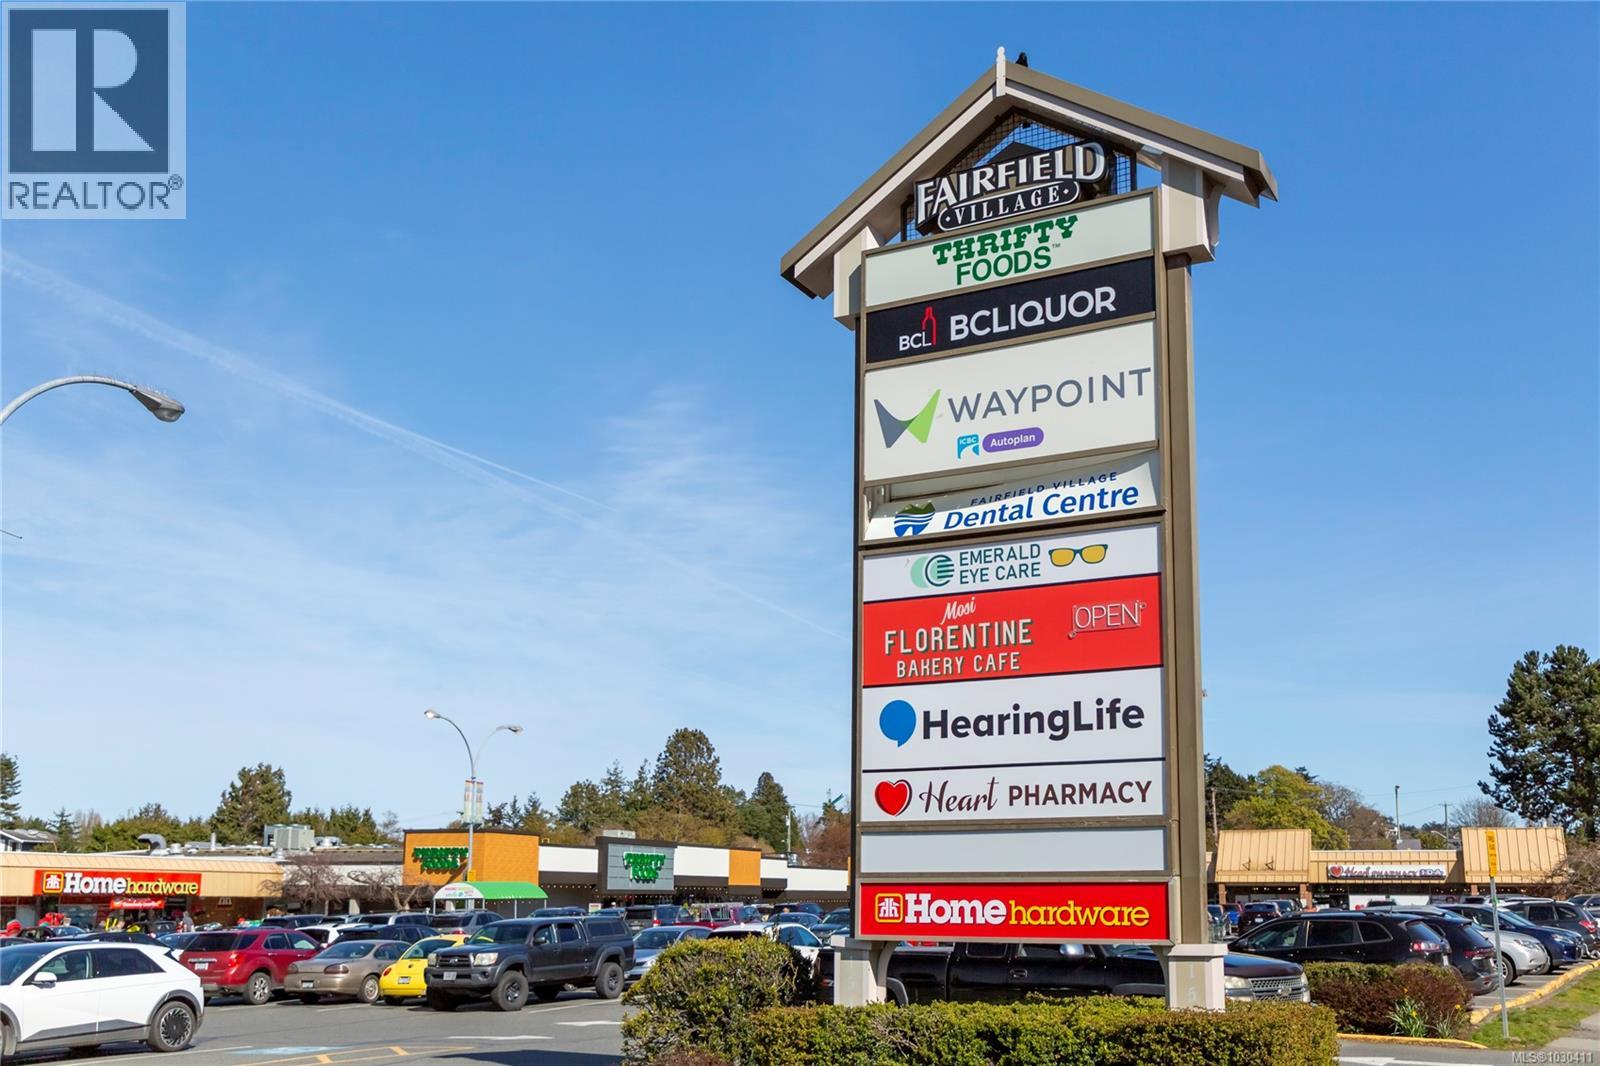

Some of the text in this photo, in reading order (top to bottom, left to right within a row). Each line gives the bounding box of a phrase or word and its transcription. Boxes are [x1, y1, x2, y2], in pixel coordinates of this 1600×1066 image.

[917, 142, 1107, 225] FAIRFIELD
[954, 187, 1060, 223] VILLAGE
[932, 214, 1078, 266] THRIFTY
[949, 286, 1117, 342] BCLIQUOR
[948, 367, 1152, 423] WAYPOINT
[959, 432, 1037, 449] ICBC Autoplan
[970, 471, 1118, 506] FAIRFIELD VILLAGE
[943, 485, 1139, 531] Dental Centre
[959, 543, 1041, 568] EMERALD
[959, 563, 1041, 585] EYE CARE
[940, 596, 976, 626] Mosi
[1075, 602, 1138, 629] OPEN
[884, 618, 1033, 655] FLORENTINE
[896, 651, 1021, 679] BAKERY CAFE
[922, 697, 1145, 742] HearingLife
[919, 776, 1152, 814] Heart PHARMACY
[63, 872, 199, 896] Home hardware
[905, 893, 1151, 927] Home hardware
